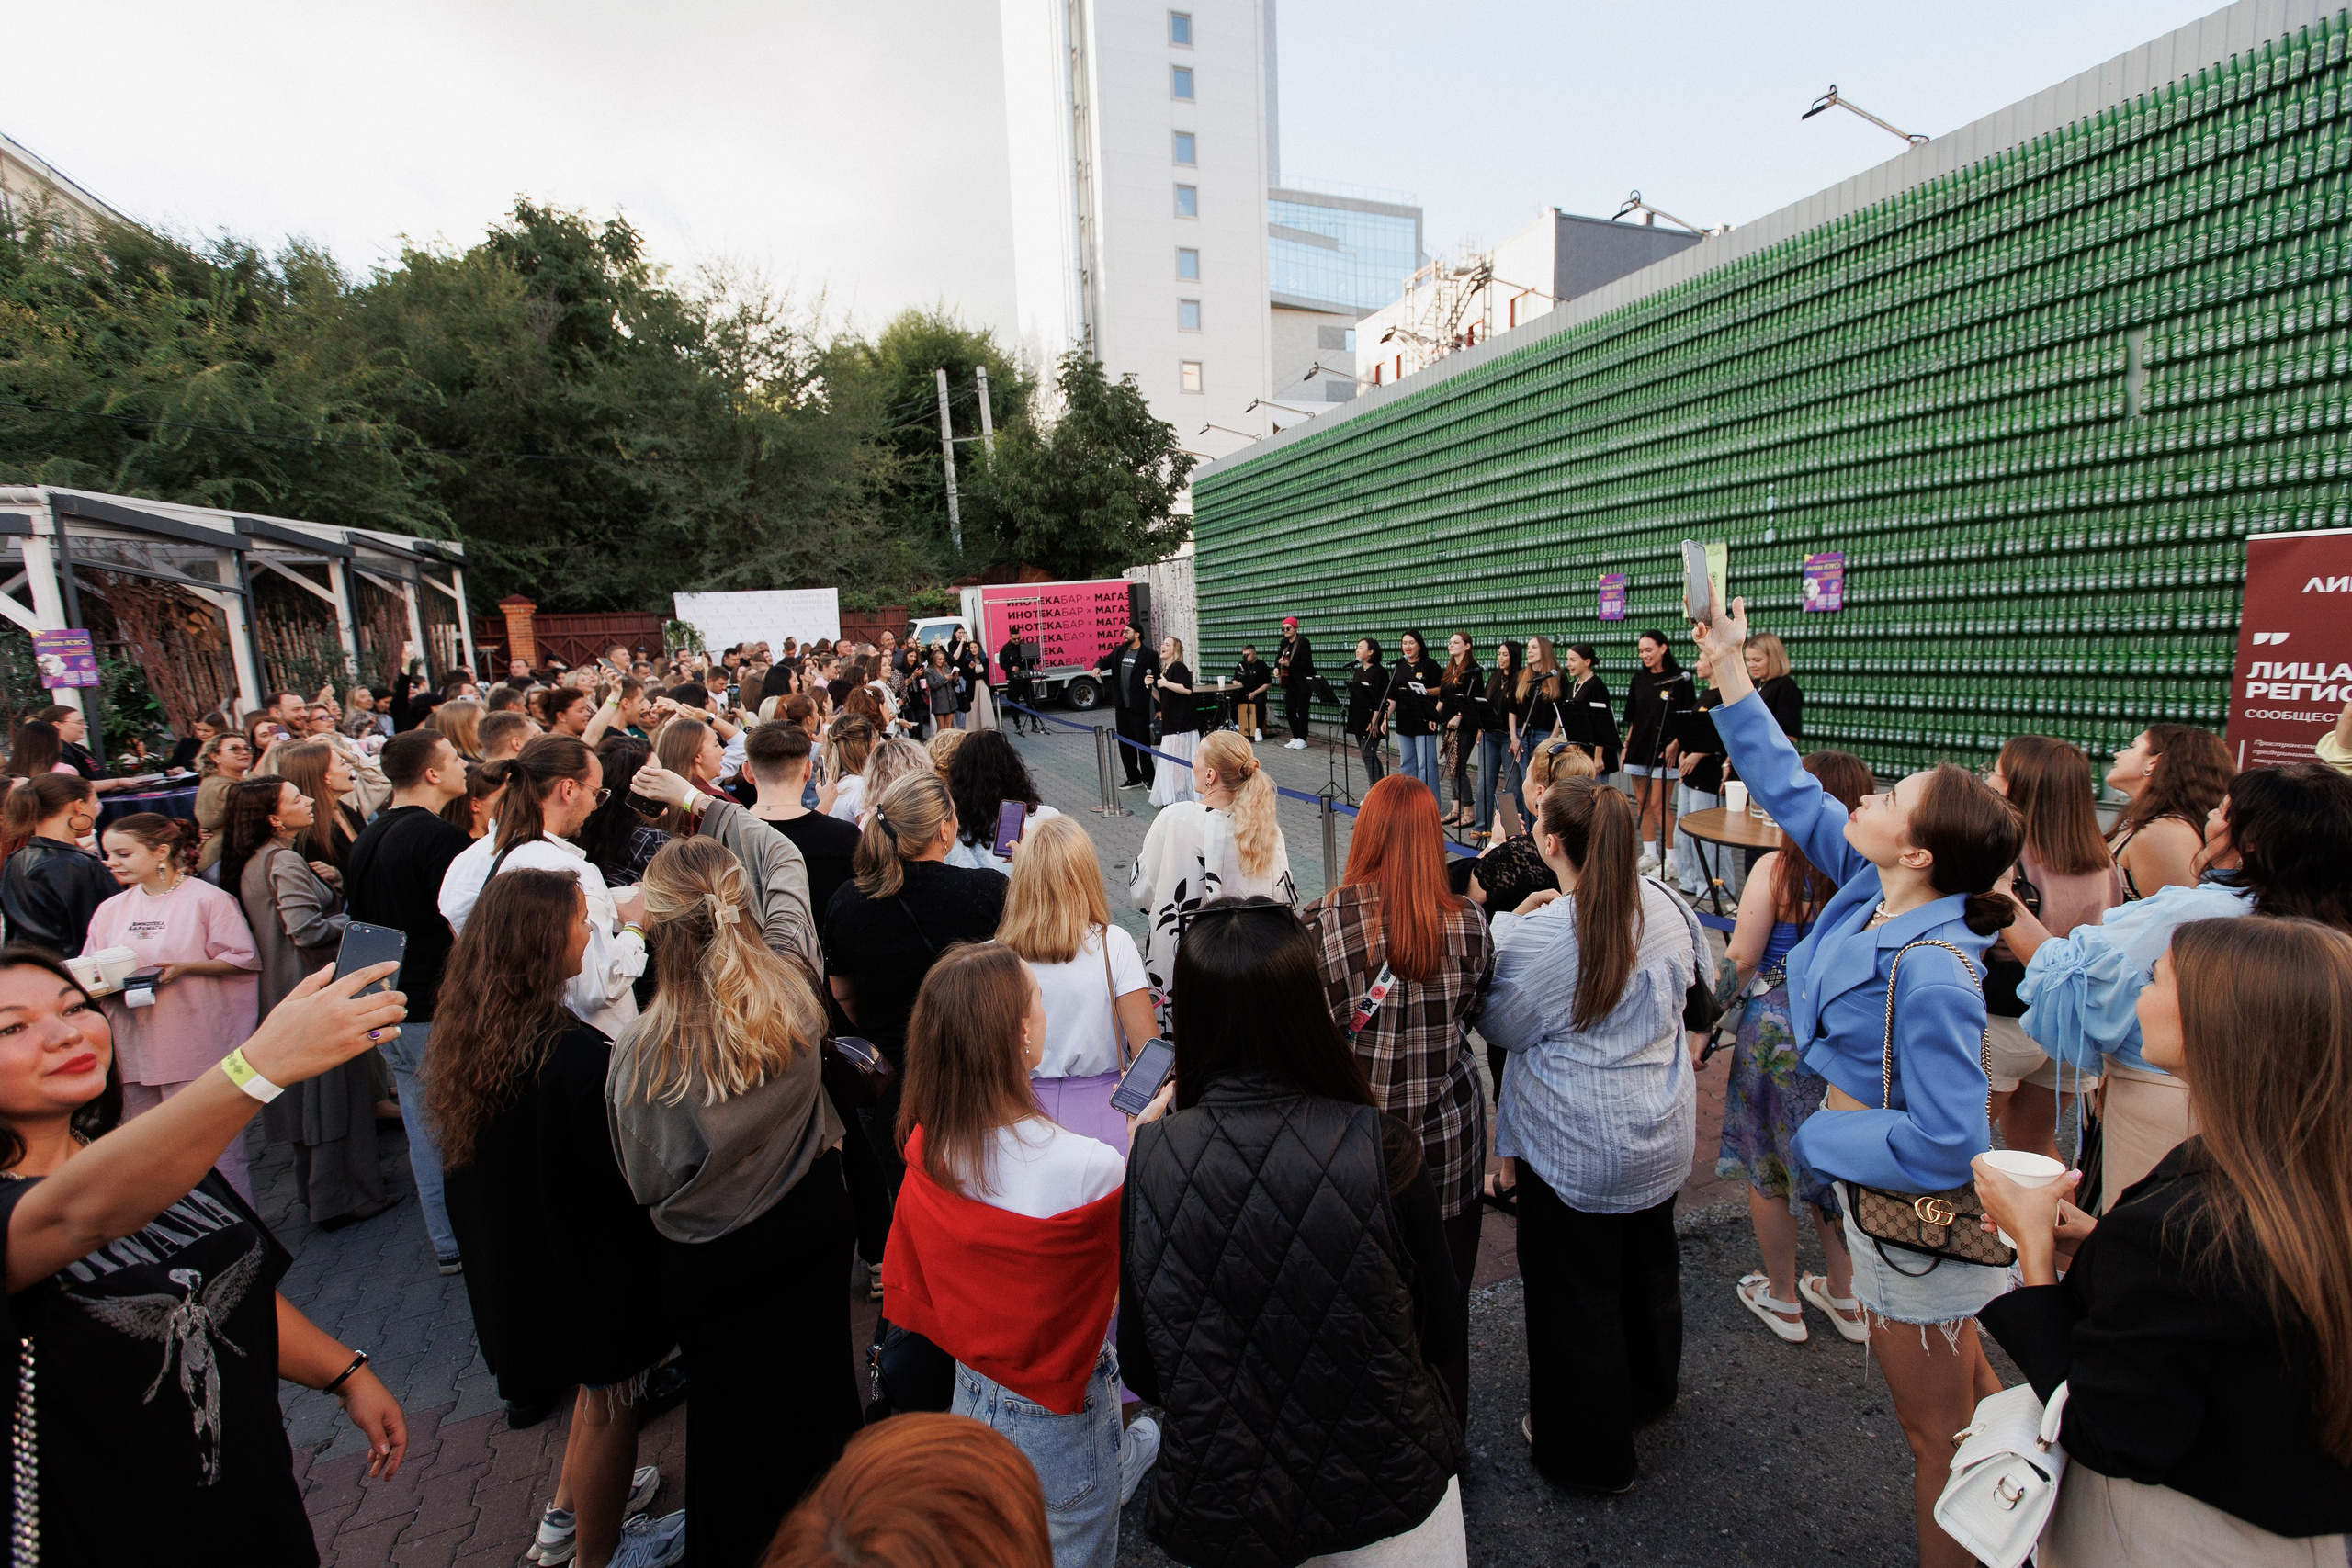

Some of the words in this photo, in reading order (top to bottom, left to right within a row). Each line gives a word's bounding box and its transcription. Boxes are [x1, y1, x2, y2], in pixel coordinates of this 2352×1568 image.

[2301, 576, 2352, 593] ЛИ
[1008, 607, 1083, 619] ИНОТЕКАБАР
[2245, 662, 2352, 683] ЛИЦА
